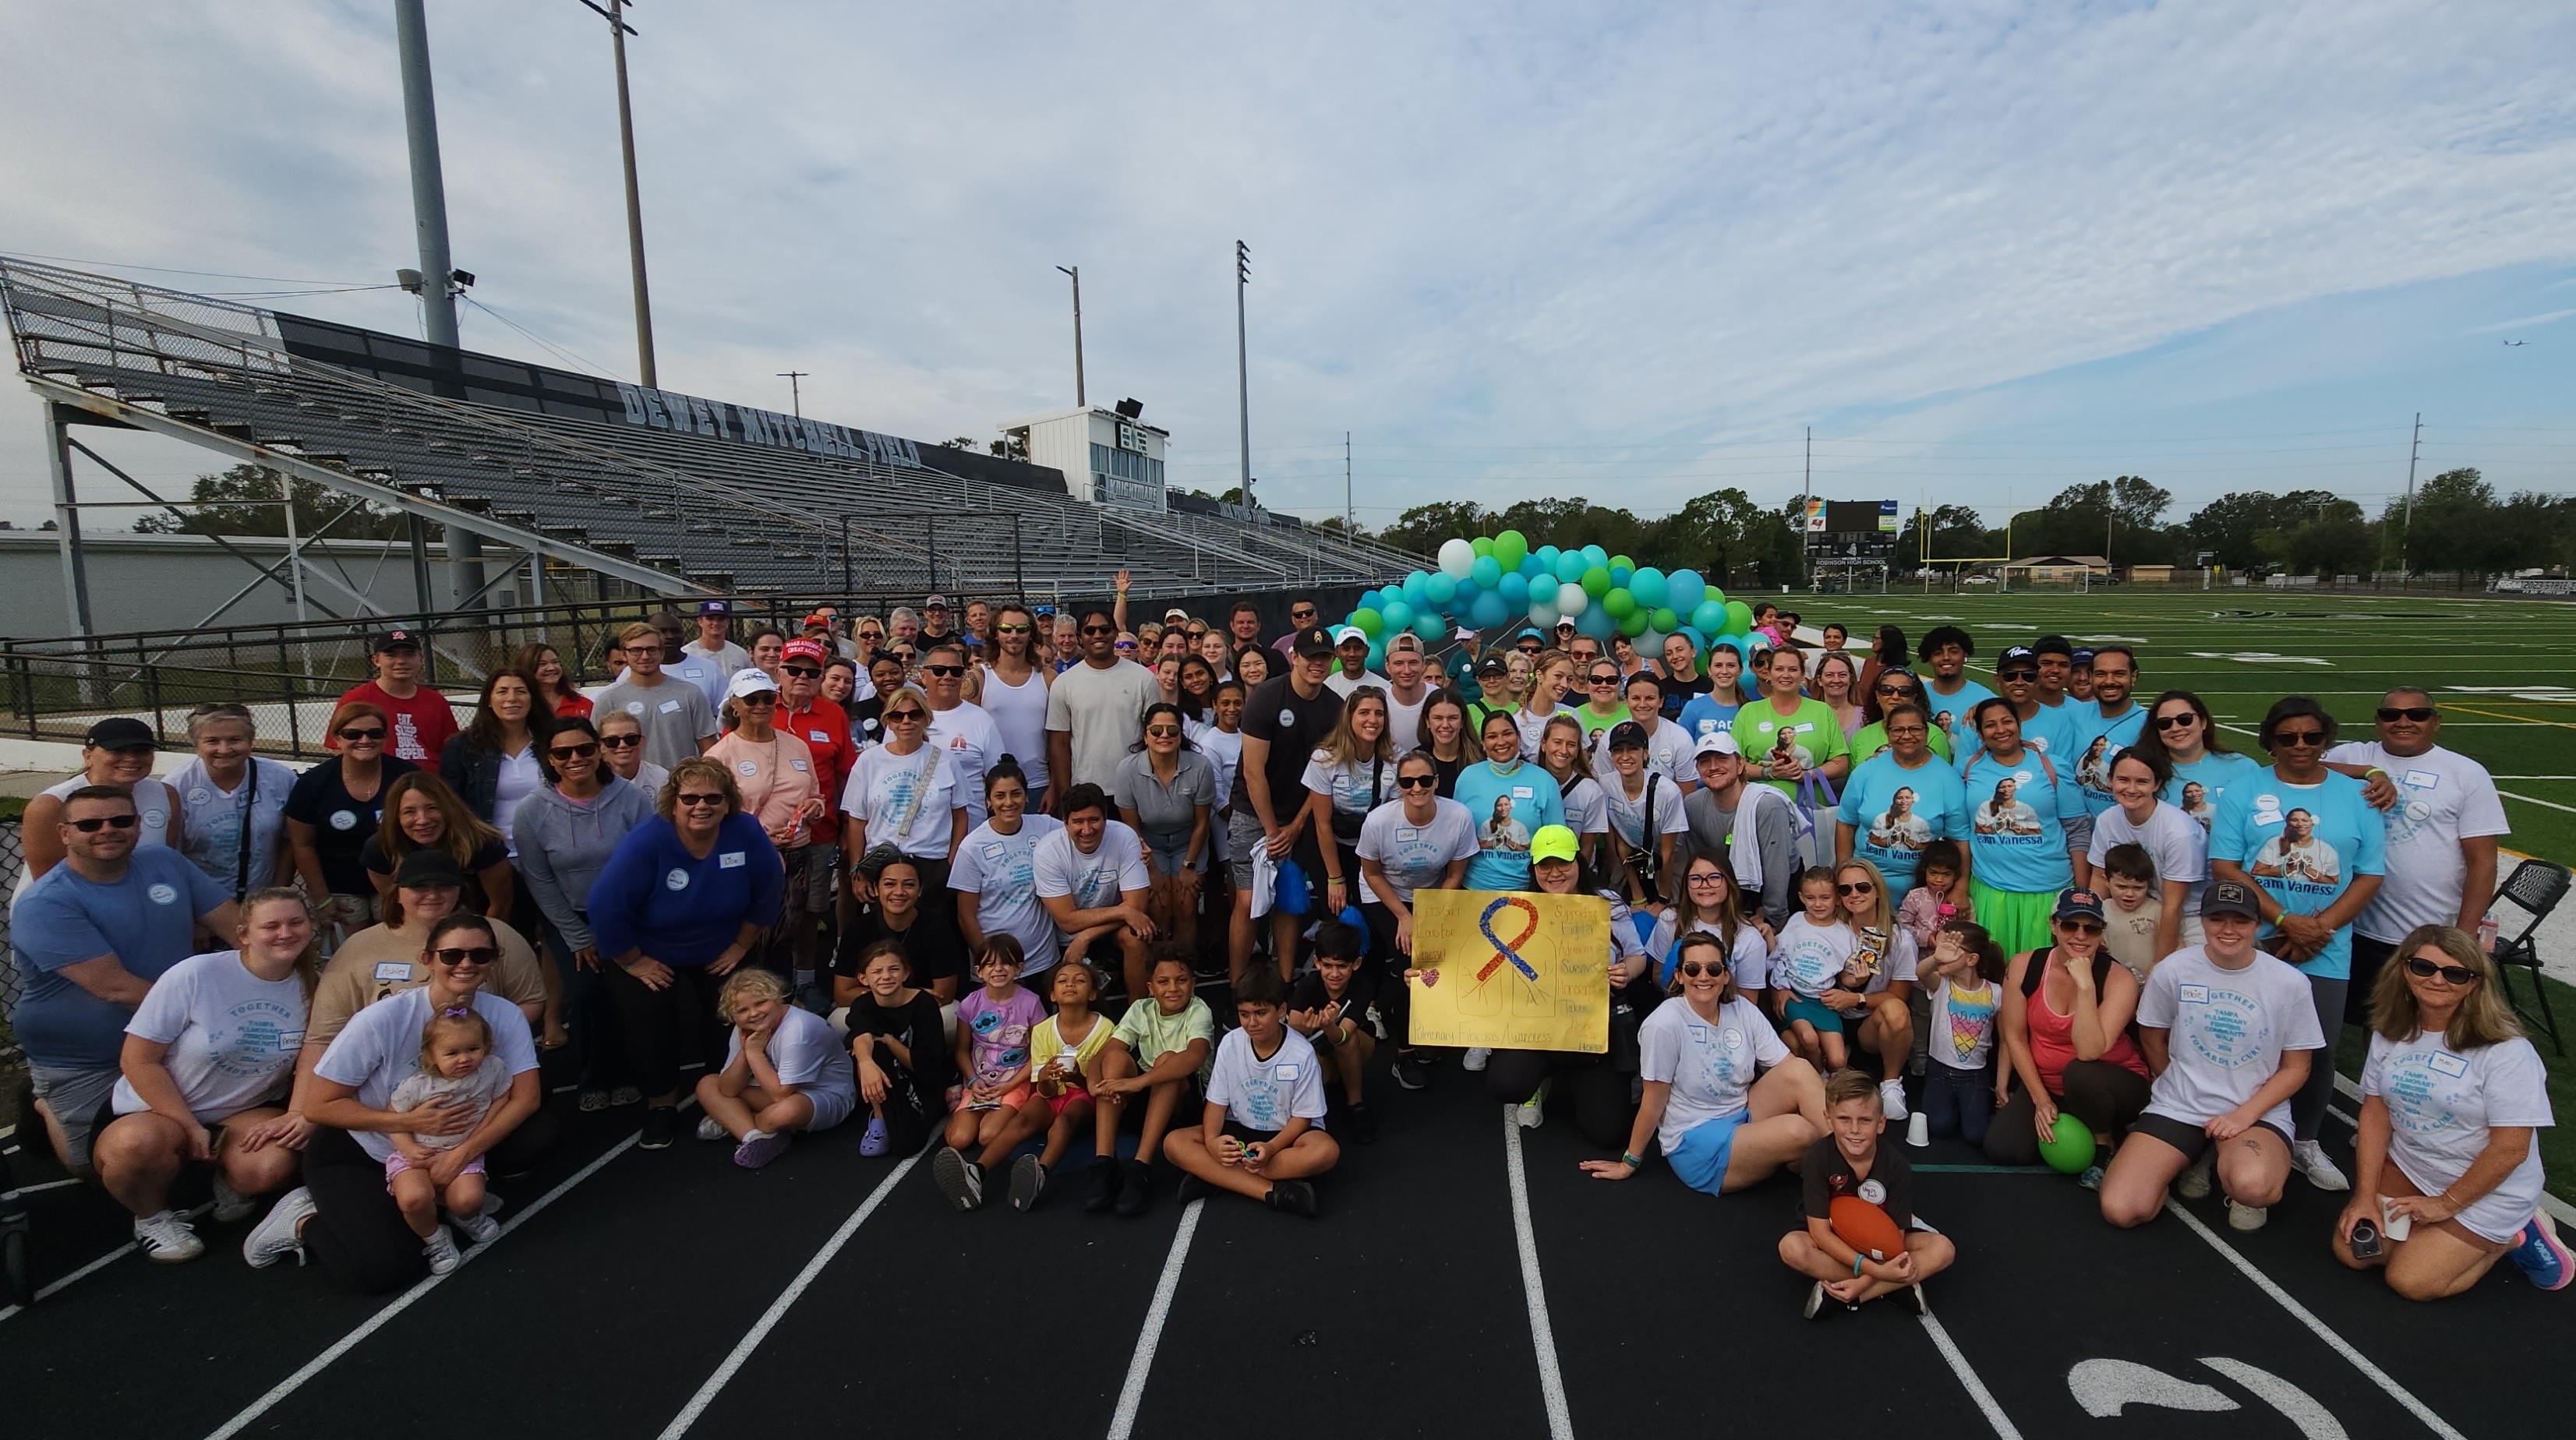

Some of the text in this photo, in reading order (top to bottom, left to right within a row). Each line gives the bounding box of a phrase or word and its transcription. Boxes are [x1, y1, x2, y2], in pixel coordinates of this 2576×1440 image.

[616, 381, 730, 439] DEWEY
[861, 431, 921, 468] FIELD
[800, 641, 823, 652] AMERICA
[804, 648, 821, 656] AGAIN
[2083, 788, 2117, 803] Vaness
[2001, 835, 2043, 845] Vanessa
[1398, 842, 1438, 856] TOGETHER
[1866, 842, 1922, 860] Team Vanes
[2257, 877, 2284, 890] eam
[2210, 992, 2255, 1011] GETHER
[229, 1002, 292, 1019] TOGETHER
[2214, 1009, 2239, 1018] TAMPA
[2204, 1014, 2248, 1025] PULMONARY
[2210, 1021, 2242, 1031] FIBROSIS
[1414, 1020, 1454, 1044] Pulmonary
[1458, 1022, 1498, 1045] Fibrosis
[1500, 1022, 1552, 1046] Awareness
[2204, 1026, 2246, 1037] COMMUNITY
[2215, 1033, 2235, 1043] WALK
[2189, 1034, 2230, 1066] TOWARDS
[2241, 1045, 2261, 1061] CURE
[2392, 1075, 2436, 1089] PULMONARY
[2404, 1071, 2428, 1080] TAMPA
[1241, 1078, 1279, 1095] TOGETHER
[2396, 1082, 2427, 1092] FIBROSIS
[2390, 1087, 2433, 1101] COMMUNITY
[1247, 1108, 1278, 1117] COMMUNITY
[2433, 1111, 2454, 1128] CURE
